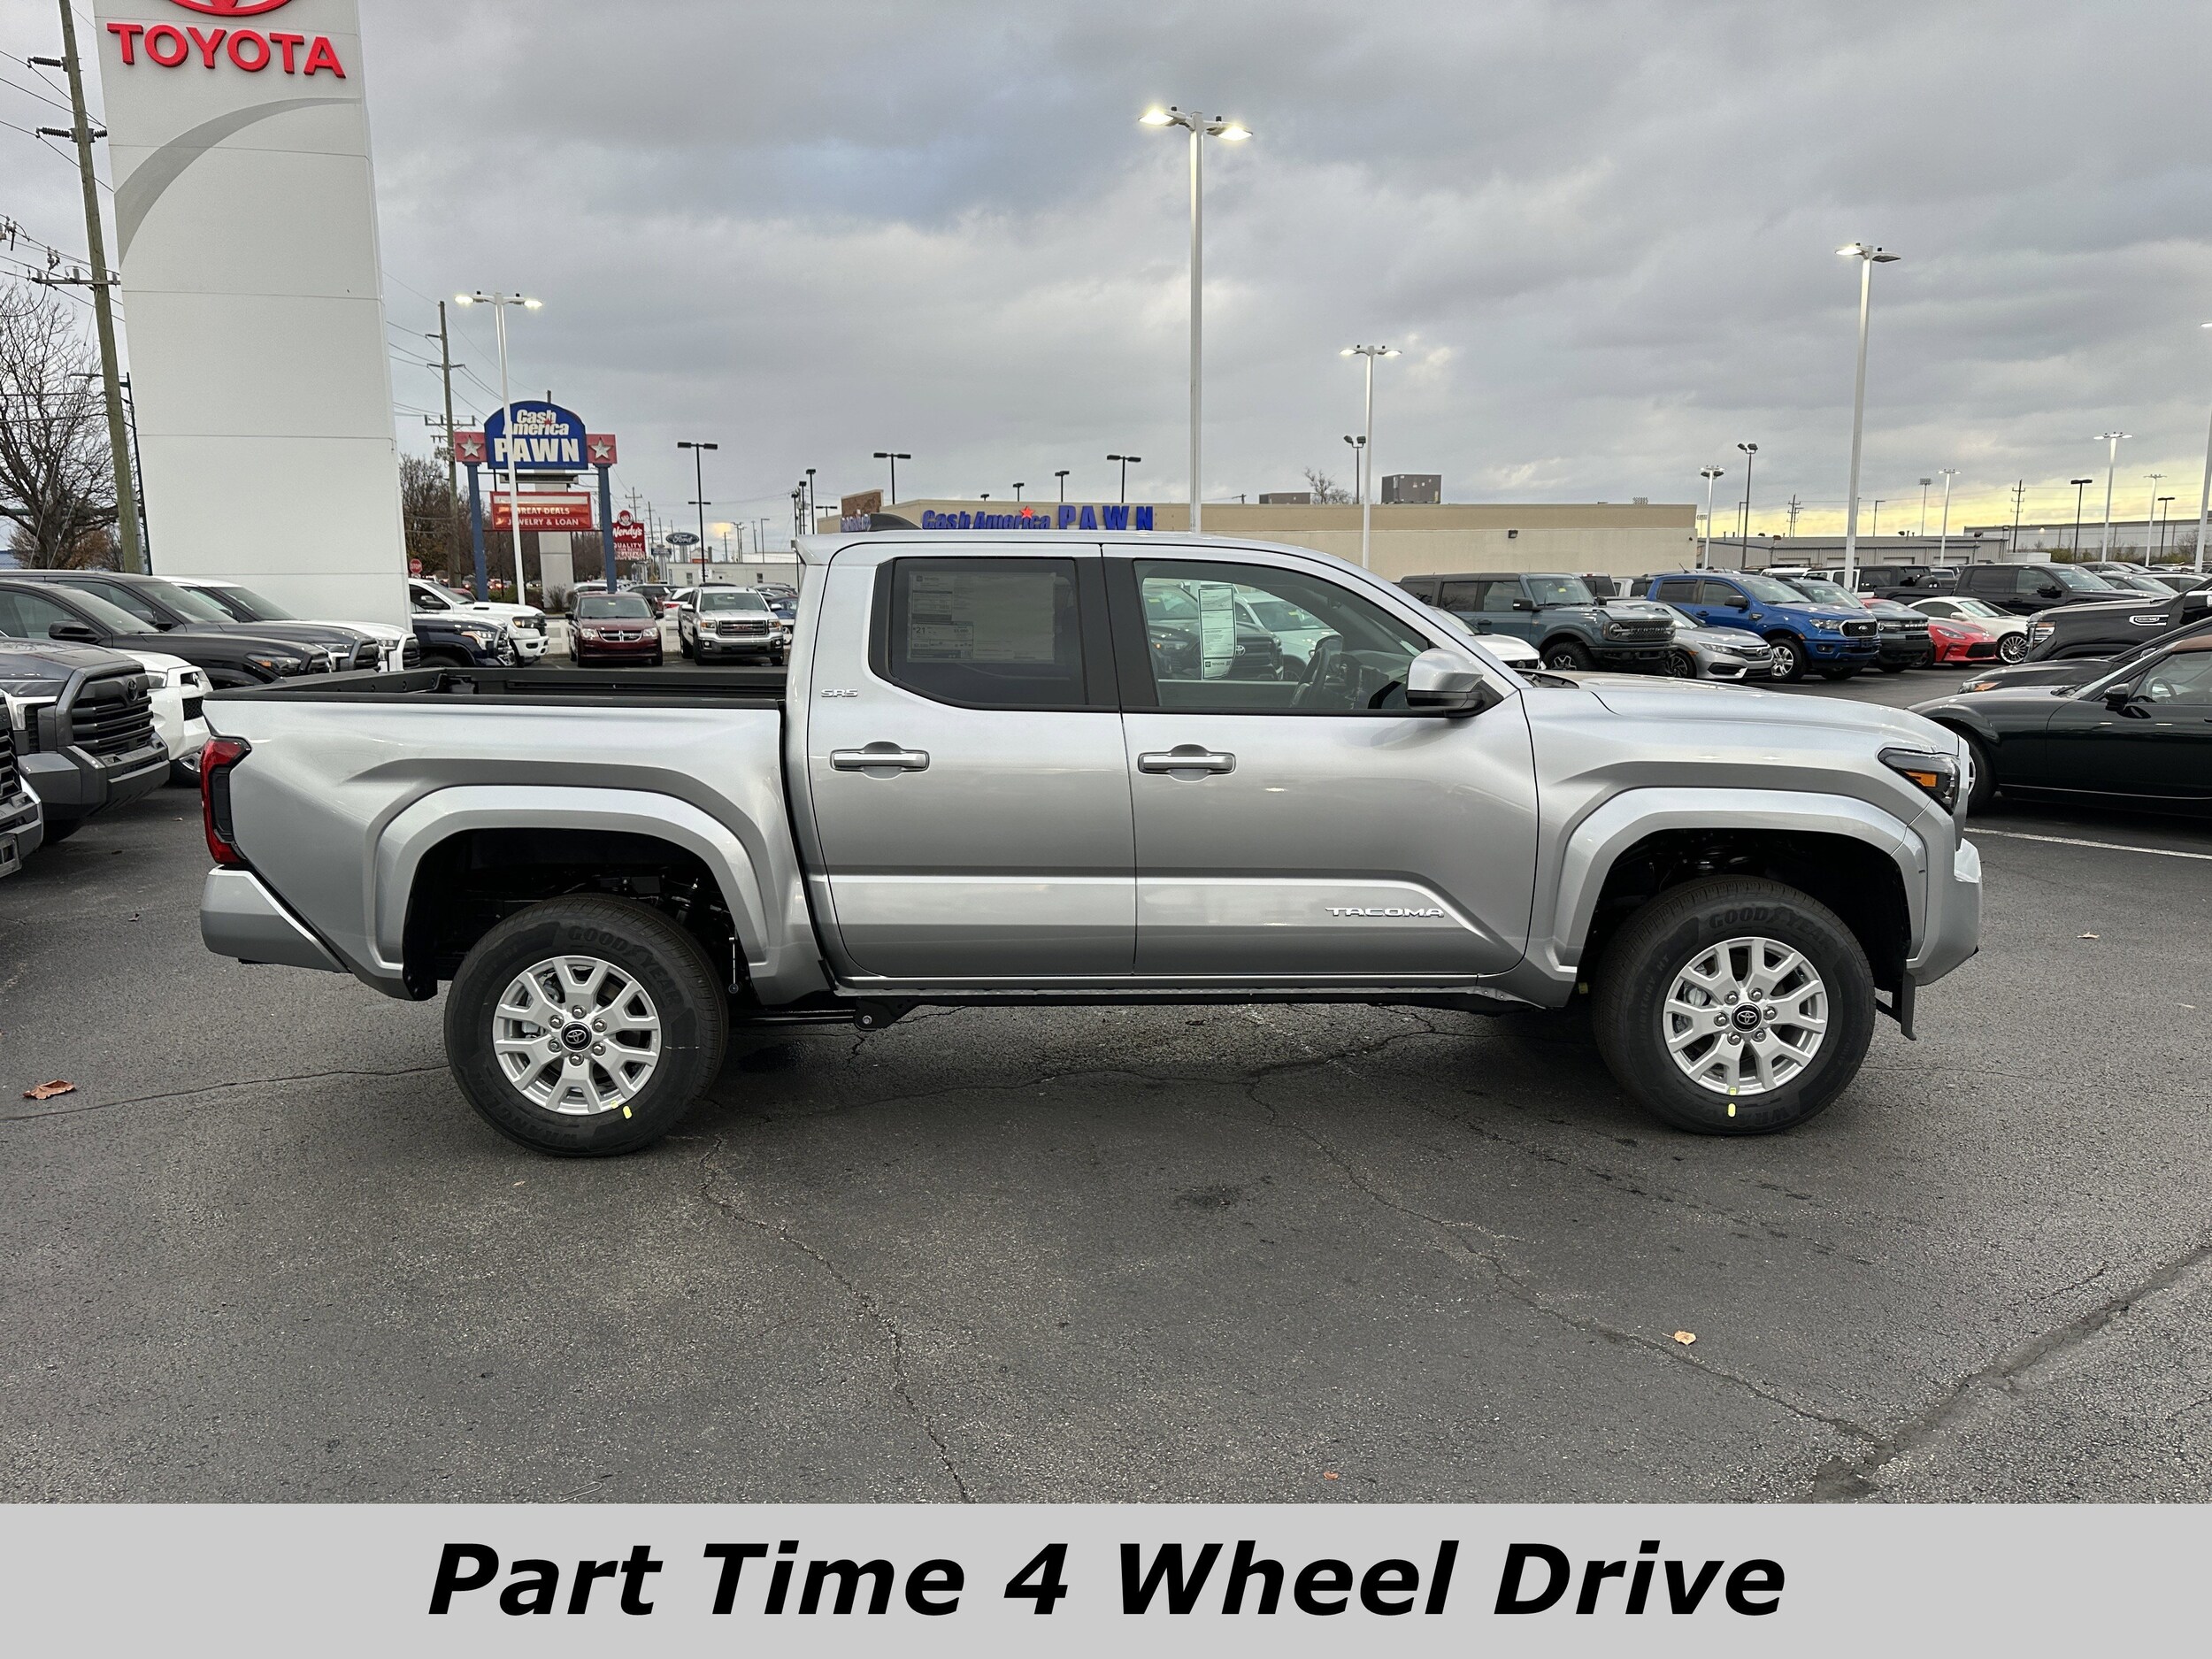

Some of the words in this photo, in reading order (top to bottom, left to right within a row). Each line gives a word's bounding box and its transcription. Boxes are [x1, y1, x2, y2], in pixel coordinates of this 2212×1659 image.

[107, 23, 344, 80] TOYOTA
[517, 409, 557, 424] Cash
[494, 437, 580, 462] PAWN
[921, 510, 972, 530] Cash
[974, 511, 1052, 530] America
[1058, 505, 1154, 530] PAWN
[821, 688, 858, 698] SR5
[1325, 907, 1445, 918] TACOMA
